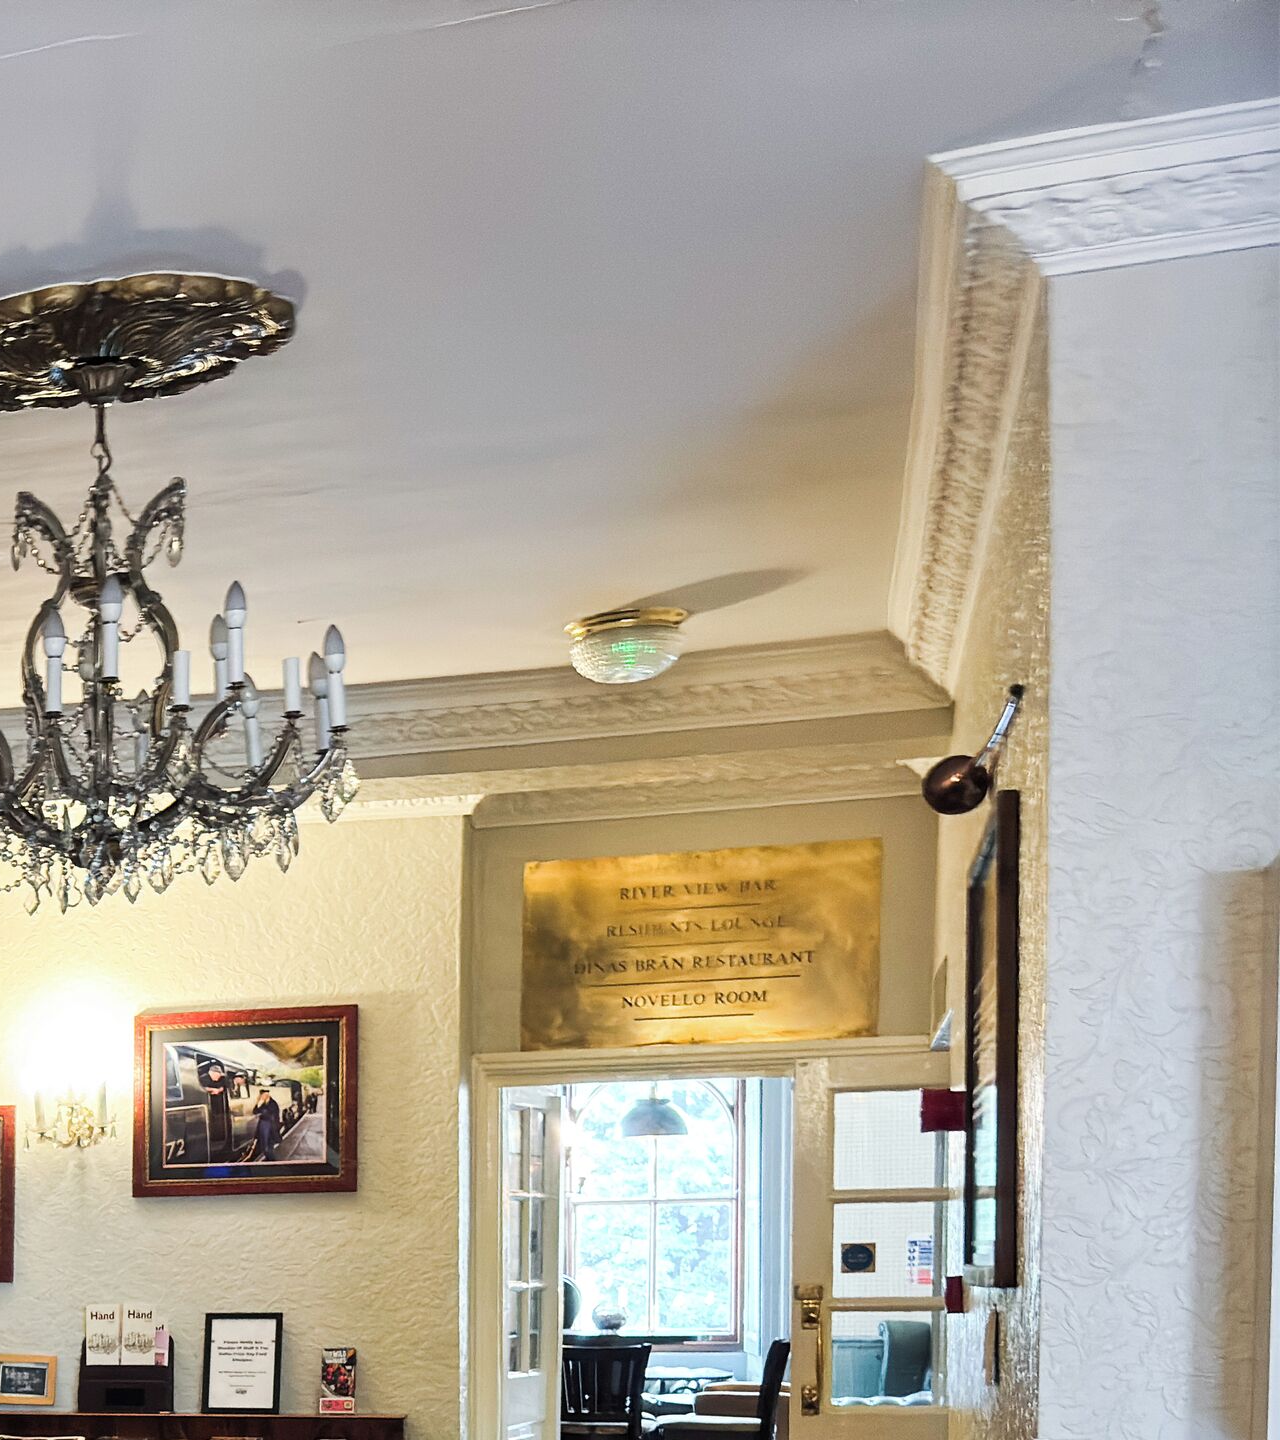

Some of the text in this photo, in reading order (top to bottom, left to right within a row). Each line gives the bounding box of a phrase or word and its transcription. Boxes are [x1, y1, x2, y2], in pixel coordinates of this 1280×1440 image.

[619, 879, 778, 900] RIVER VIEW BAR
[710, 915, 790, 932] LOUNGE
[573, 960, 627, 975] DINAS
[692, 950, 816, 969] RESTAURANT
[621, 990, 768, 1009] NOVELLO ROOM
[166, 1139, 185, 1160] 72
[90, 1311, 115, 1320] Hand
[127, 1309, 153, 1319] Hand
